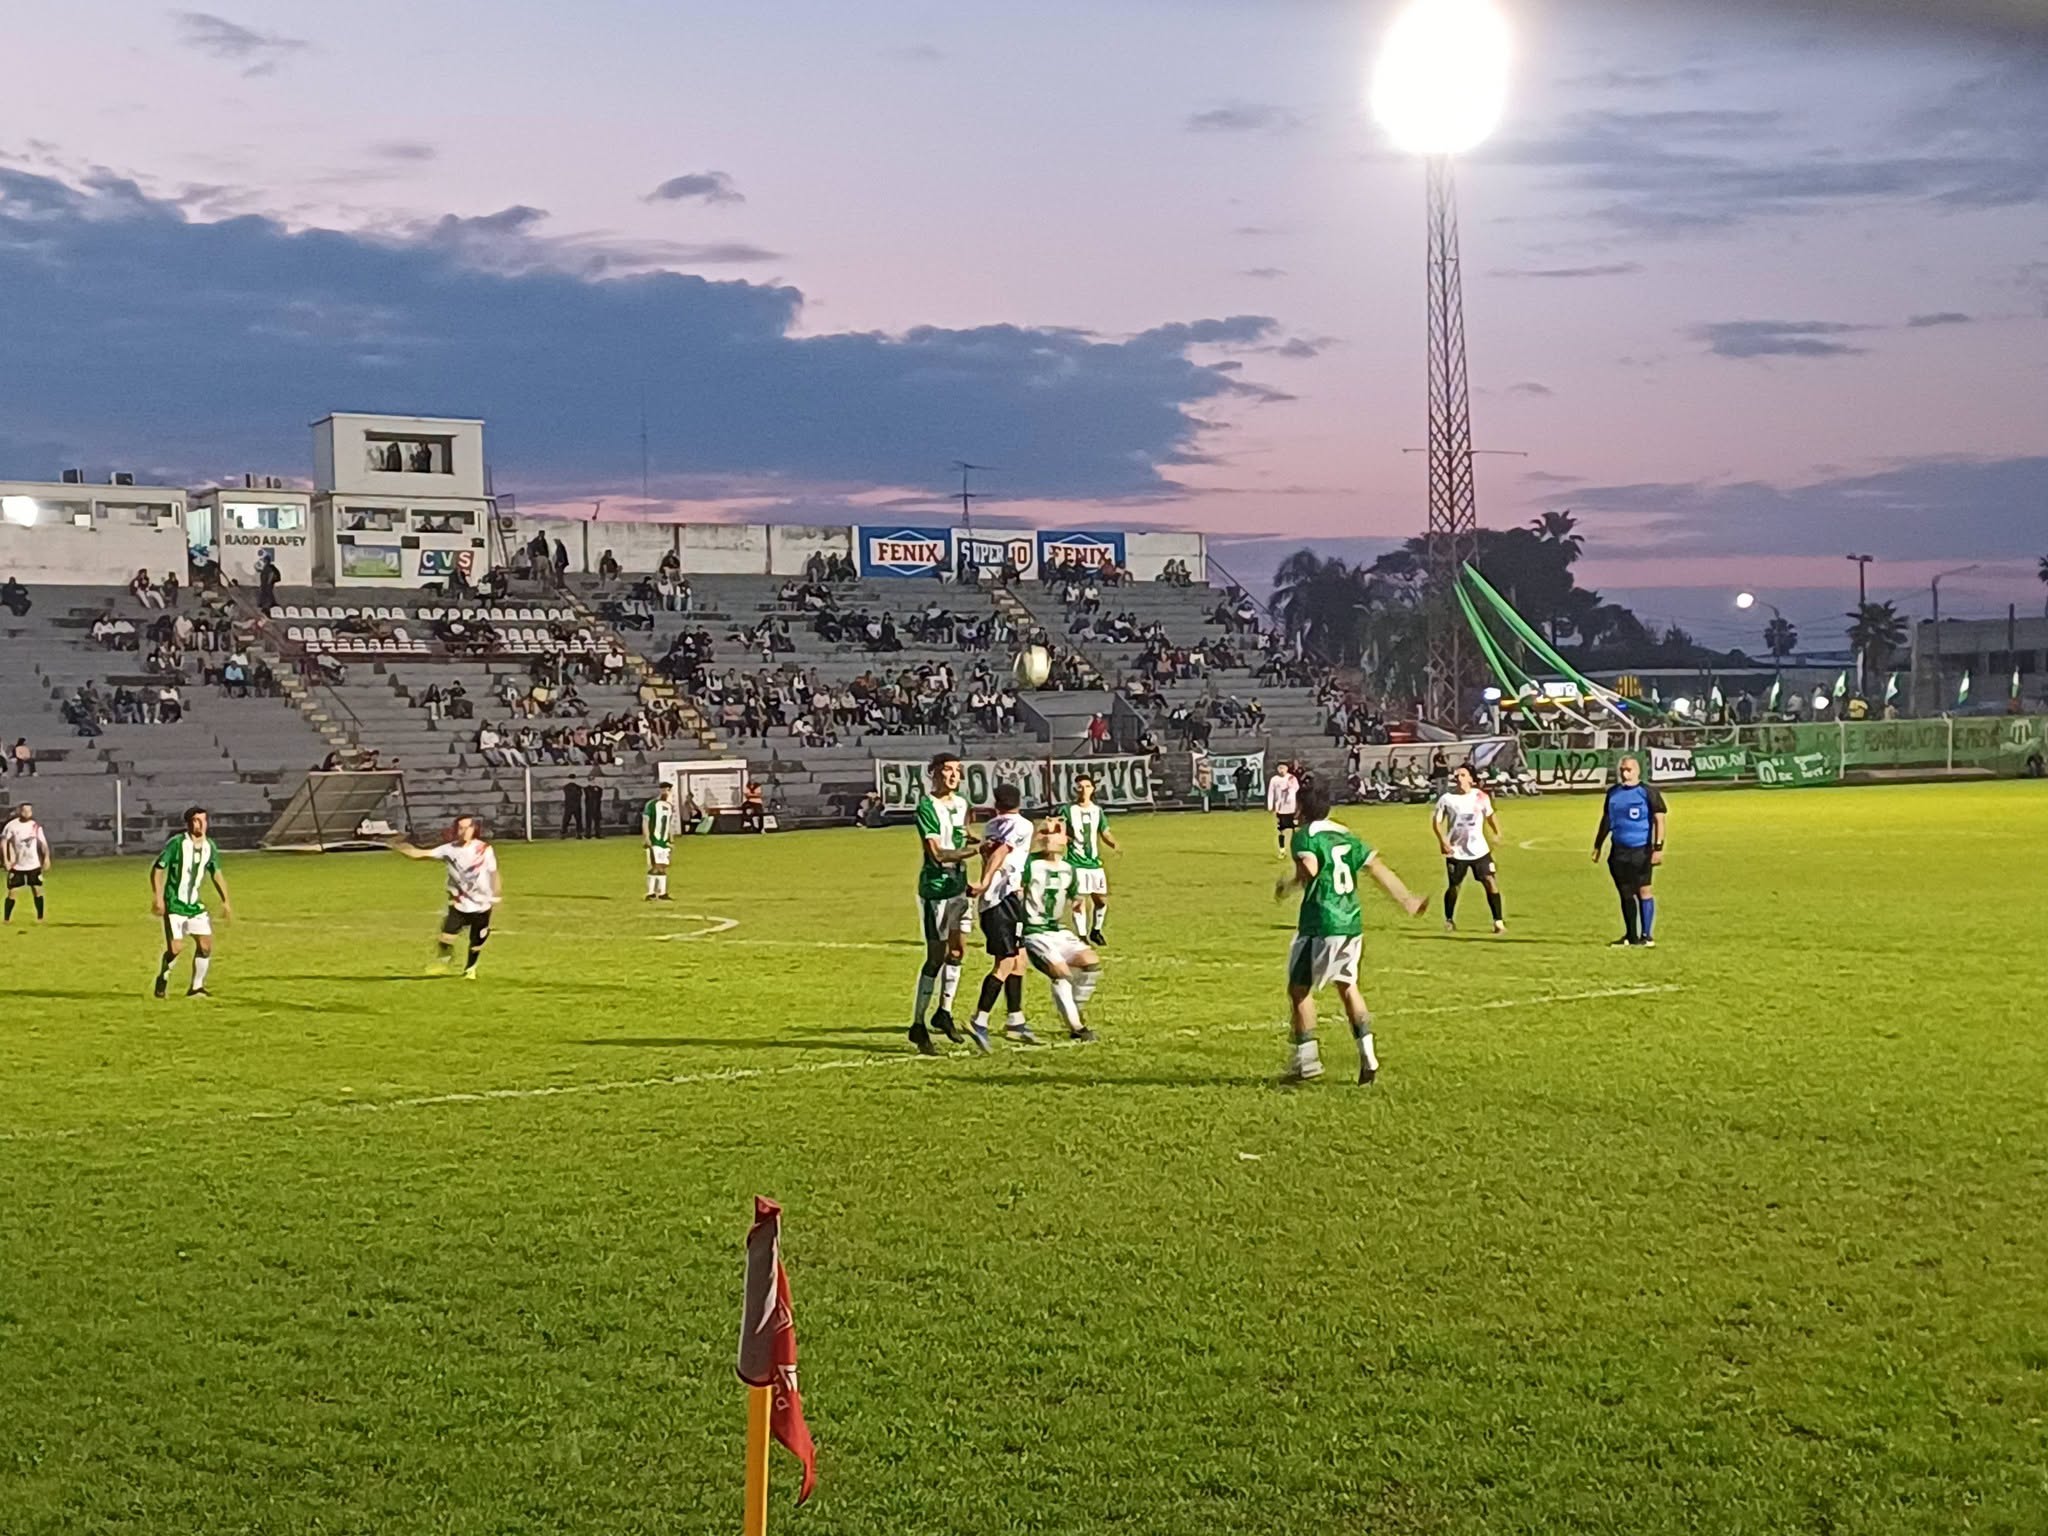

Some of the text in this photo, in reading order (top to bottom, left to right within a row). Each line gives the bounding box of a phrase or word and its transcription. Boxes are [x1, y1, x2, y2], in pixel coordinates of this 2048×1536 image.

[225, 534, 260, 545] RADIO
[423, 550, 472, 568] CVS
[878, 542, 939, 562] FENIX
[961, 541, 1027, 564] SUPER 10
[1049, 544, 1110, 565] FENIX
[883, 763, 988, 804] SAO
[1331, 844, 1354, 895] 6
